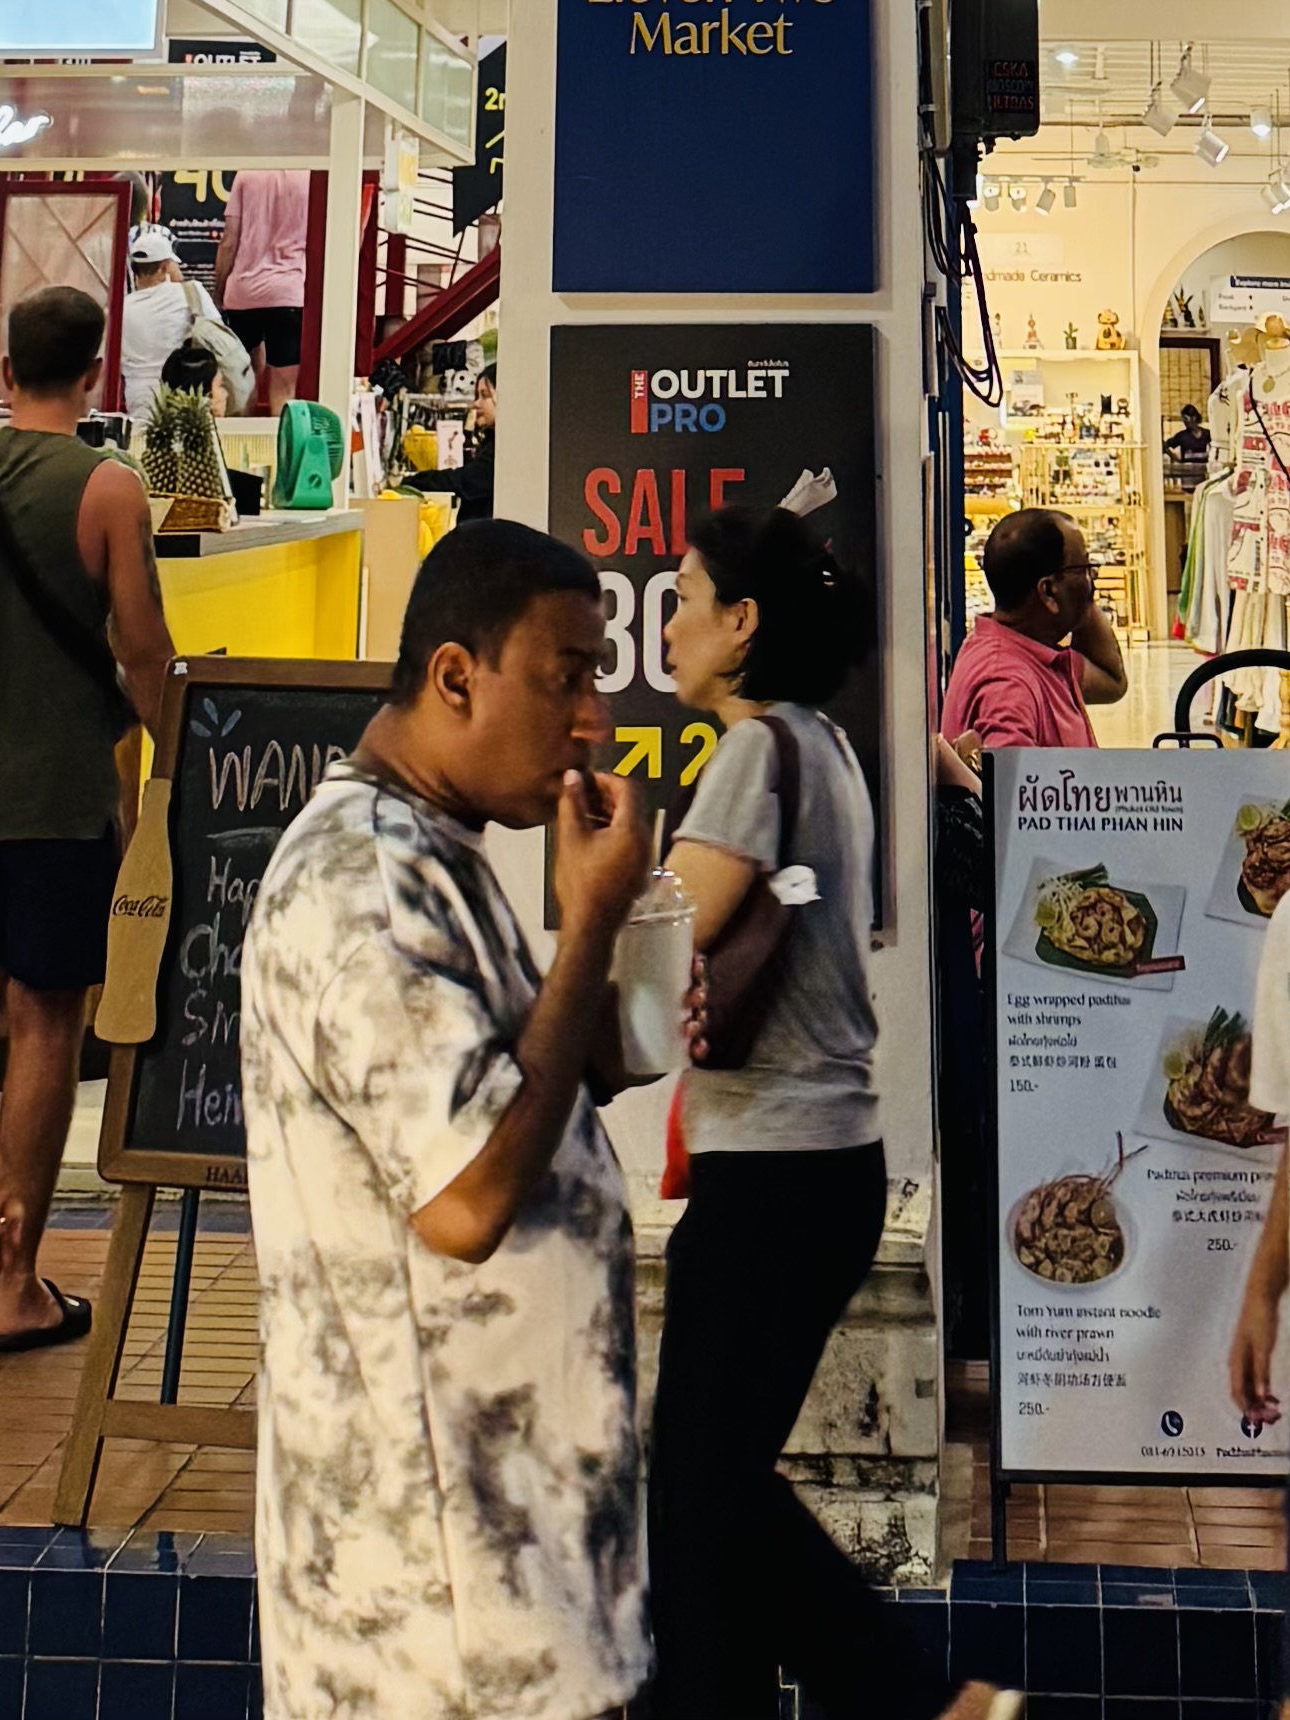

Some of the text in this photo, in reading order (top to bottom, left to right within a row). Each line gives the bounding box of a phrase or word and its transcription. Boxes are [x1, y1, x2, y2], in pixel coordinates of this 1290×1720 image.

[629, 7, 794, 56] Market
[1030, 269, 1082, 282] Ceramics
[634, 373, 645, 400] THE
[650, 369, 790, 400] OUTLET
[650, 403, 727, 433] PRO
[1018, 769, 1111, 812] ผัดไทย
[1018, 816, 1183, 831] PAD THAI PHAN HIN
